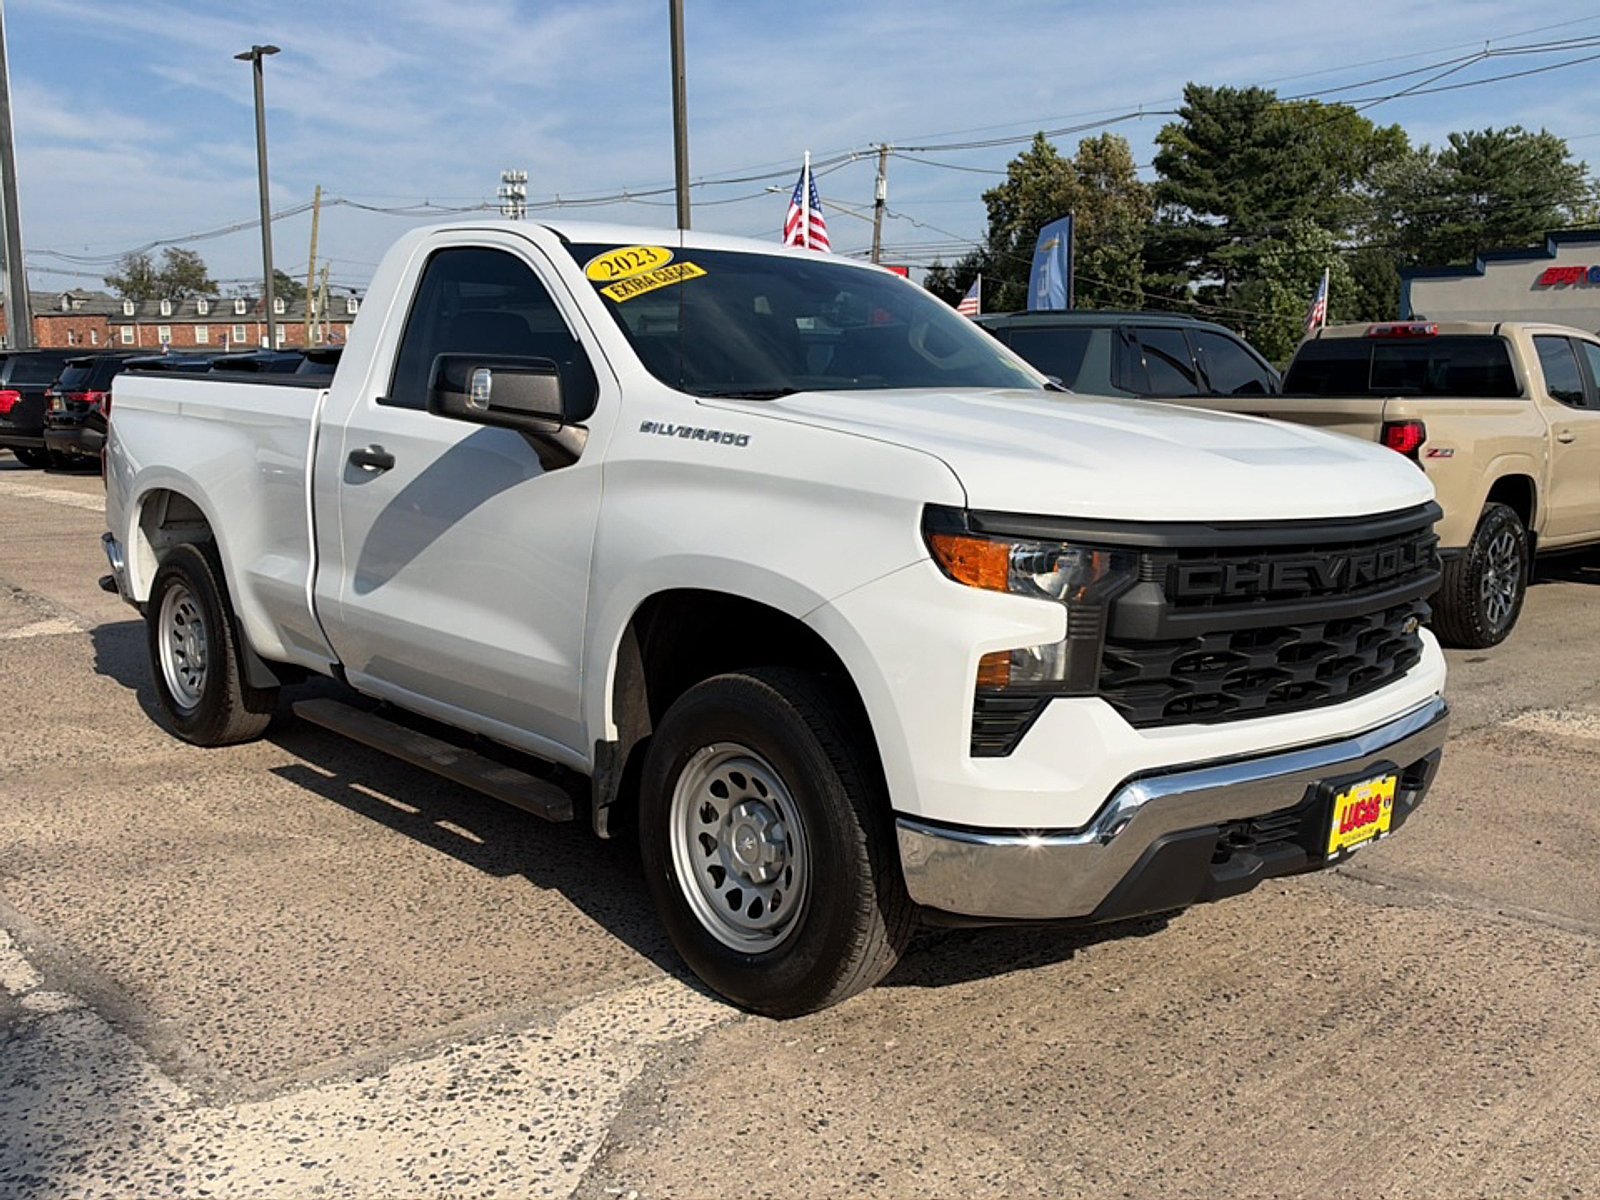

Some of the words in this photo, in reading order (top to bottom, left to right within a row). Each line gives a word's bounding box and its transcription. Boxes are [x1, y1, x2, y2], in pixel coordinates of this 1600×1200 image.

[600, 248, 658, 277] 2023
[610, 275, 657, 298] EXTRA
[652, 264, 695, 282] CLEAN
[639, 420, 752, 447] SILVERADO
